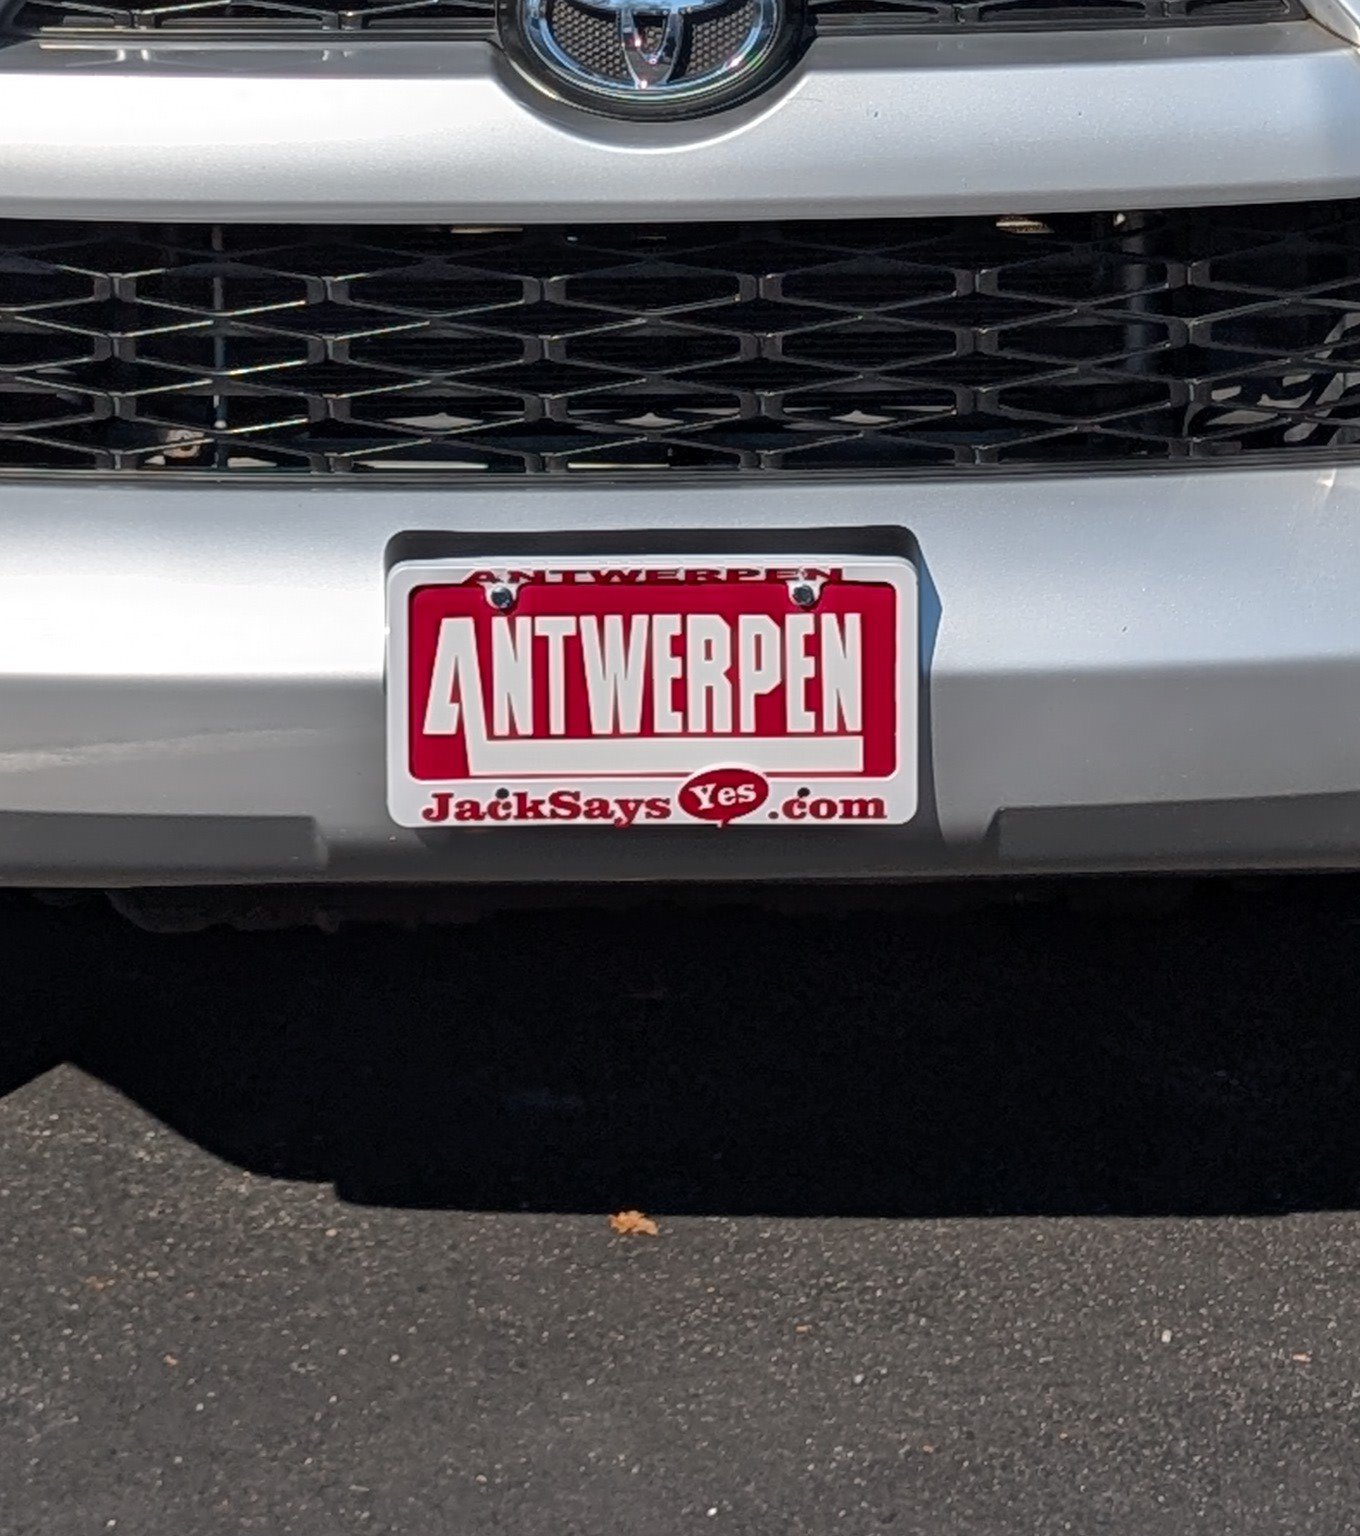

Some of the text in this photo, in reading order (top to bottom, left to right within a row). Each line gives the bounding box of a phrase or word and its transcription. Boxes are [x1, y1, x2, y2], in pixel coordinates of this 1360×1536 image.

[462, 567, 843, 584] ANTWERPEN
[422, 612, 864, 736] ANTWERPEN
[421, 782, 888, 828] JackSays Yes .com
